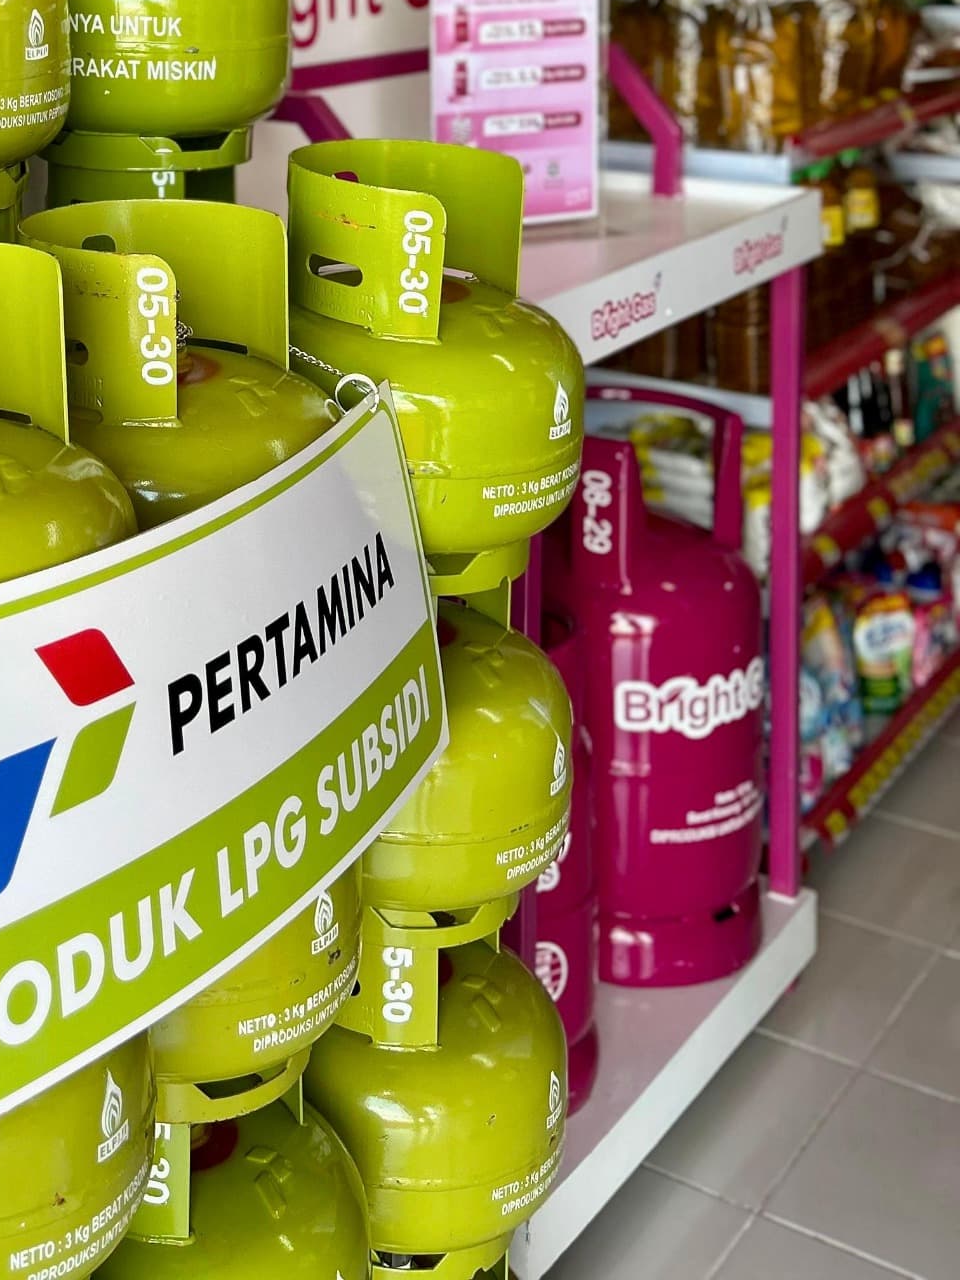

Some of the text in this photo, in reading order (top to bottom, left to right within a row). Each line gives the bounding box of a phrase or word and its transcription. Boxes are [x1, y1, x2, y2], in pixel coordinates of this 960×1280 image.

[68, 13, 182, 37] NYA UNTUK
[147, 55, 217, 81] MISKIN
[7, 97, 18, 112] Kg
[19, 92, 42, 109] BERAT
[27, 111, 48, 126] UNTUK
[398, 209, 433, 315] 05-30
[136, 266, 175, 386] 05-30
[482, 471, 562, 499] NETTO 3 Kg BERAT
[493, 495, 545, 518] DIPRODUKSI
[582, 469, 613, 555] 08-29
[166, 531, 395, 757] PERTAMINA
[615, 668, 744, 739] Bright
[216, 798, 309, 917] LPG
[317, 663, 432, 835] SUBSIDI
[496, 836, 545, 865] NETTO Kg
[506, 851, 550, 880] DIPRODUKSI
[312, 924, 339, 955] ELPIJI
[382, 946, 413, 1024] 5-30
[239, 1012, 277, 1036] NETTO
[284, 1007, 291, 1022] 3
[292, 1002, 306, 1021] Kg
[306, 983, 334, 1013] BERAT
[253, 999, 340, 1053] DIPRODUKSI UNTUK
[492, 1182, 520, 1201] NETTO
[10, 1197, 121, 1271] NETTO 3 Kg BERAT
[101, 1216, 129, 1254] UNTUK
